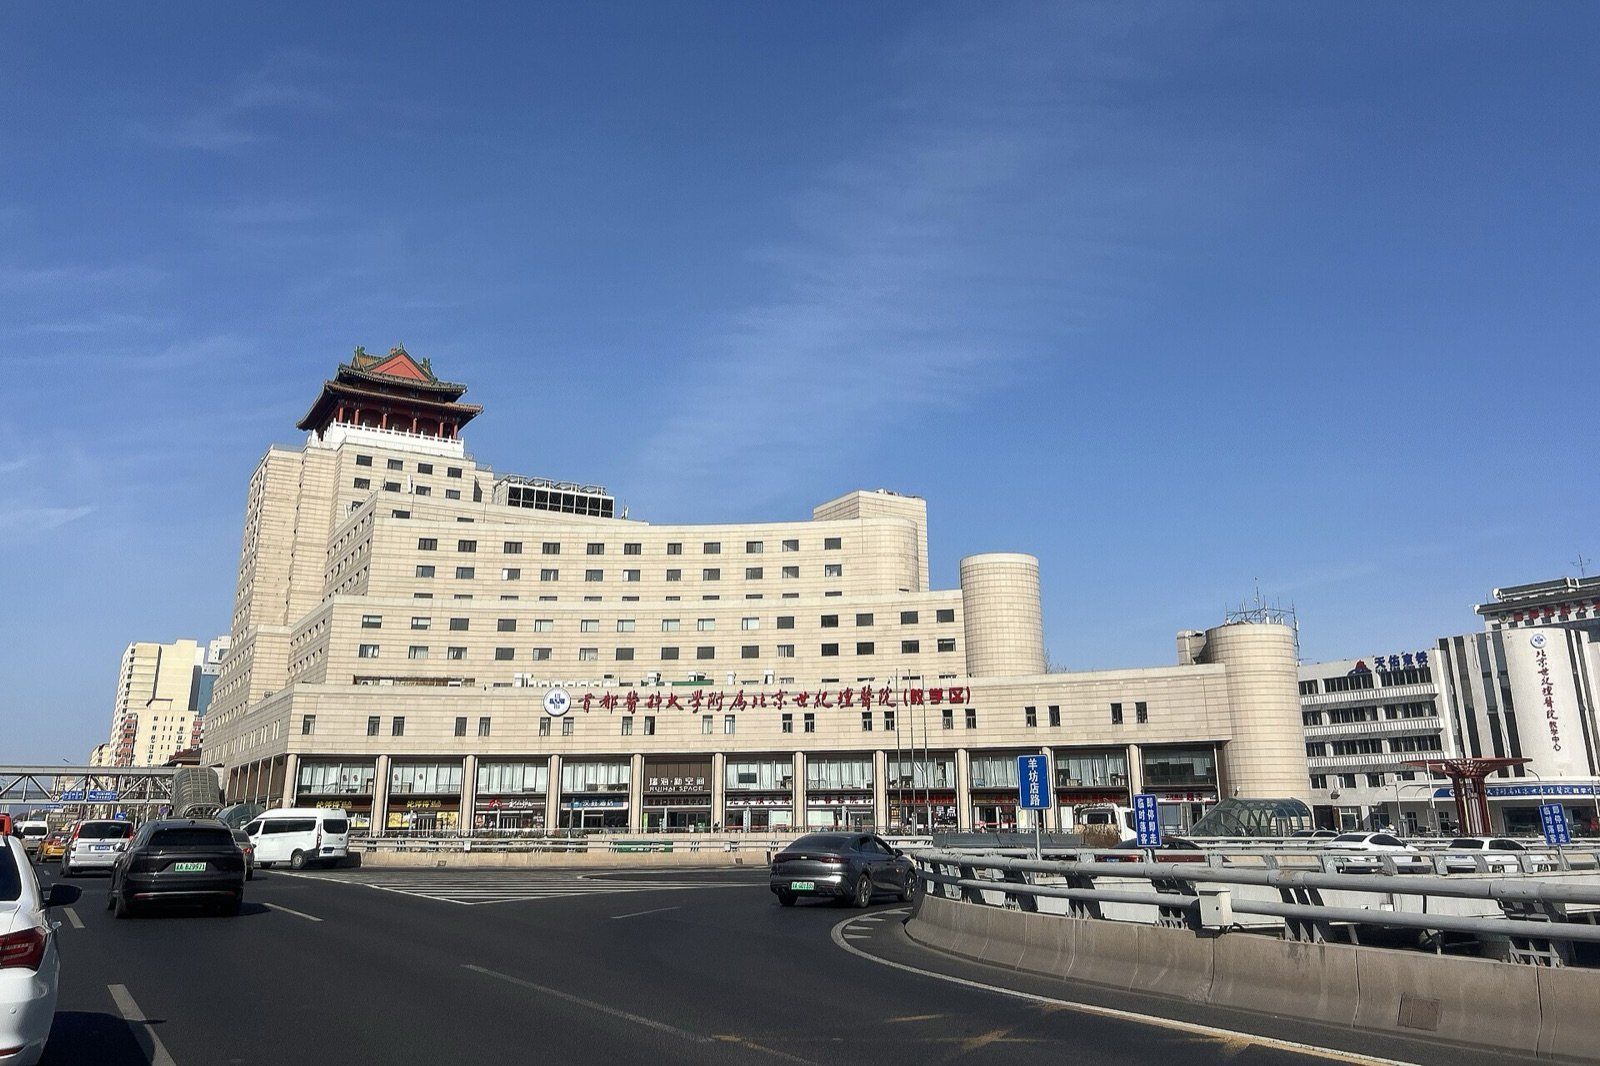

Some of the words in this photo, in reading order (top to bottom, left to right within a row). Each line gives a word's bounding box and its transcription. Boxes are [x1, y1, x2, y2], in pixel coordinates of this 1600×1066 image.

[1027, 758, 1041, 806] 羊坊店路
[936, 806, 956, 817] 早点
